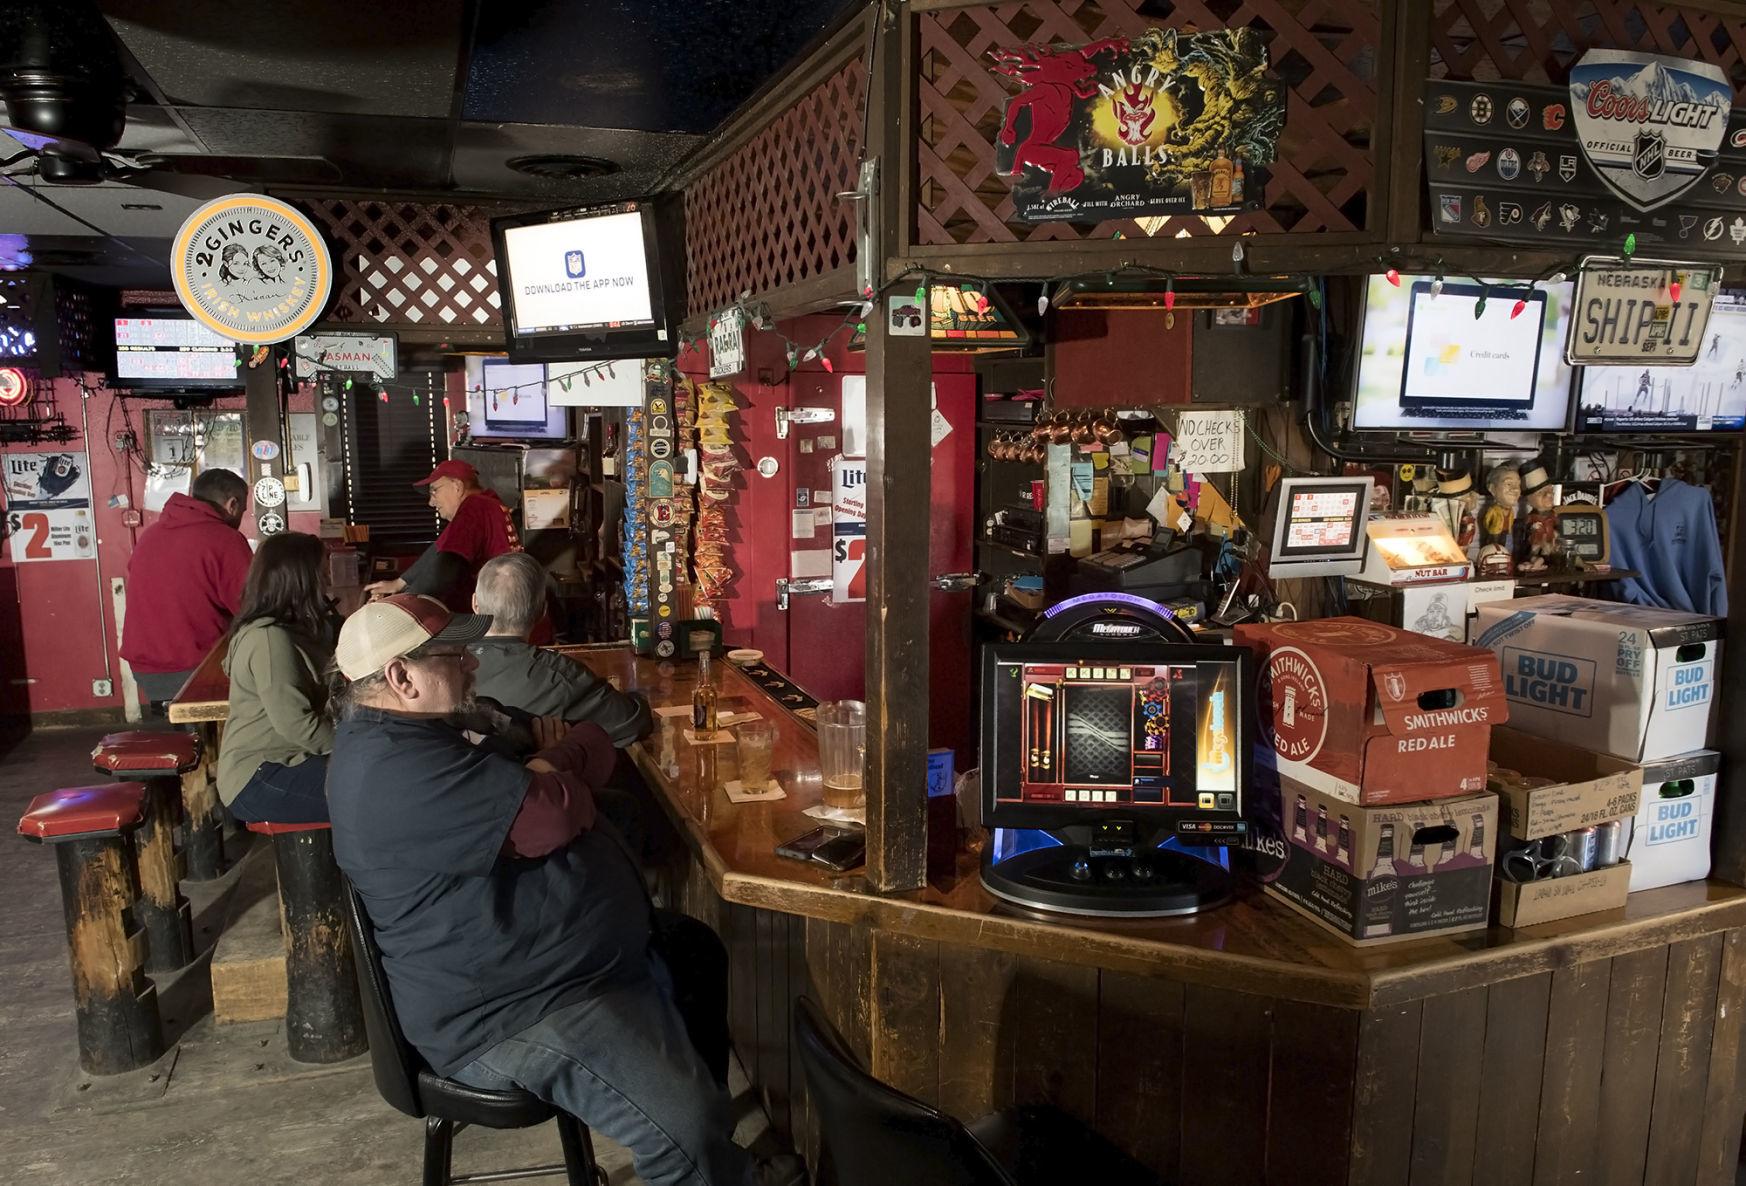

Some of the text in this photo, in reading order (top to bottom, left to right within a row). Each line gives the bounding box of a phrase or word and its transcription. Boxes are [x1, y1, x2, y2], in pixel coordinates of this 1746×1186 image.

[1098, 66, 1176, 99] ANGRY
[1586, 79, 1718, 129] Coors LIGHT
[1102, 145, 1168, 167] BALLS
[1586, 140, 1693, 159] OFFICIAL BEER
[1639, 142, 1661, 168] NHL
[1046, 196, 1079, 211] FIREBALL
[1110, 200, 1145, 208] ORCHARD
[525, 276, 634, 295] DOWNLOAD THE APP NOW
[1597, 273, 1666, 289] NEBRASKA
[200, 276, 307, 322] IRISH WHISKEY
[1179, 419, 1240, 436] NO CHECKS
[1191, 438, 1226, 451] OVER
[11, 460, 37, 474] Lite
[843, 497, 864, 508] Starting
[834, 505, 856, 517] Opening
[1432, 568, 1448, 576] BAR
[1072, 594, 1143, 603] MEGATOUCH
[1619, 631, 1636, 645] 24
[1617, 648, 1640, 659] PRY
[1518, 655, 1578, 684] BUD
[1617, 659, 1641, 668] OFF
[1675, 666, 1704, 686] BUD
[1506, 674, 1587, 710] LIGHT
[1668, 684, 1709, 706] LIGHT
[1291, 737, 1310, 756] ALE
[1398, 735, 1456, 753] RED ALE
[1679, 765, 1696, 775] PATS
[1460, 778, 1467, 790] 4
[1617, 792, 1637, 804] PACKS
[1619, 802, 1636, 814] CANS
[1658, 802, 1692, 821] BUD
[1372, 812, 1405, 823] HARD
[1650, 819, 1697, 841] LIGHT
[1367, 880, 1398, 897] mike's
